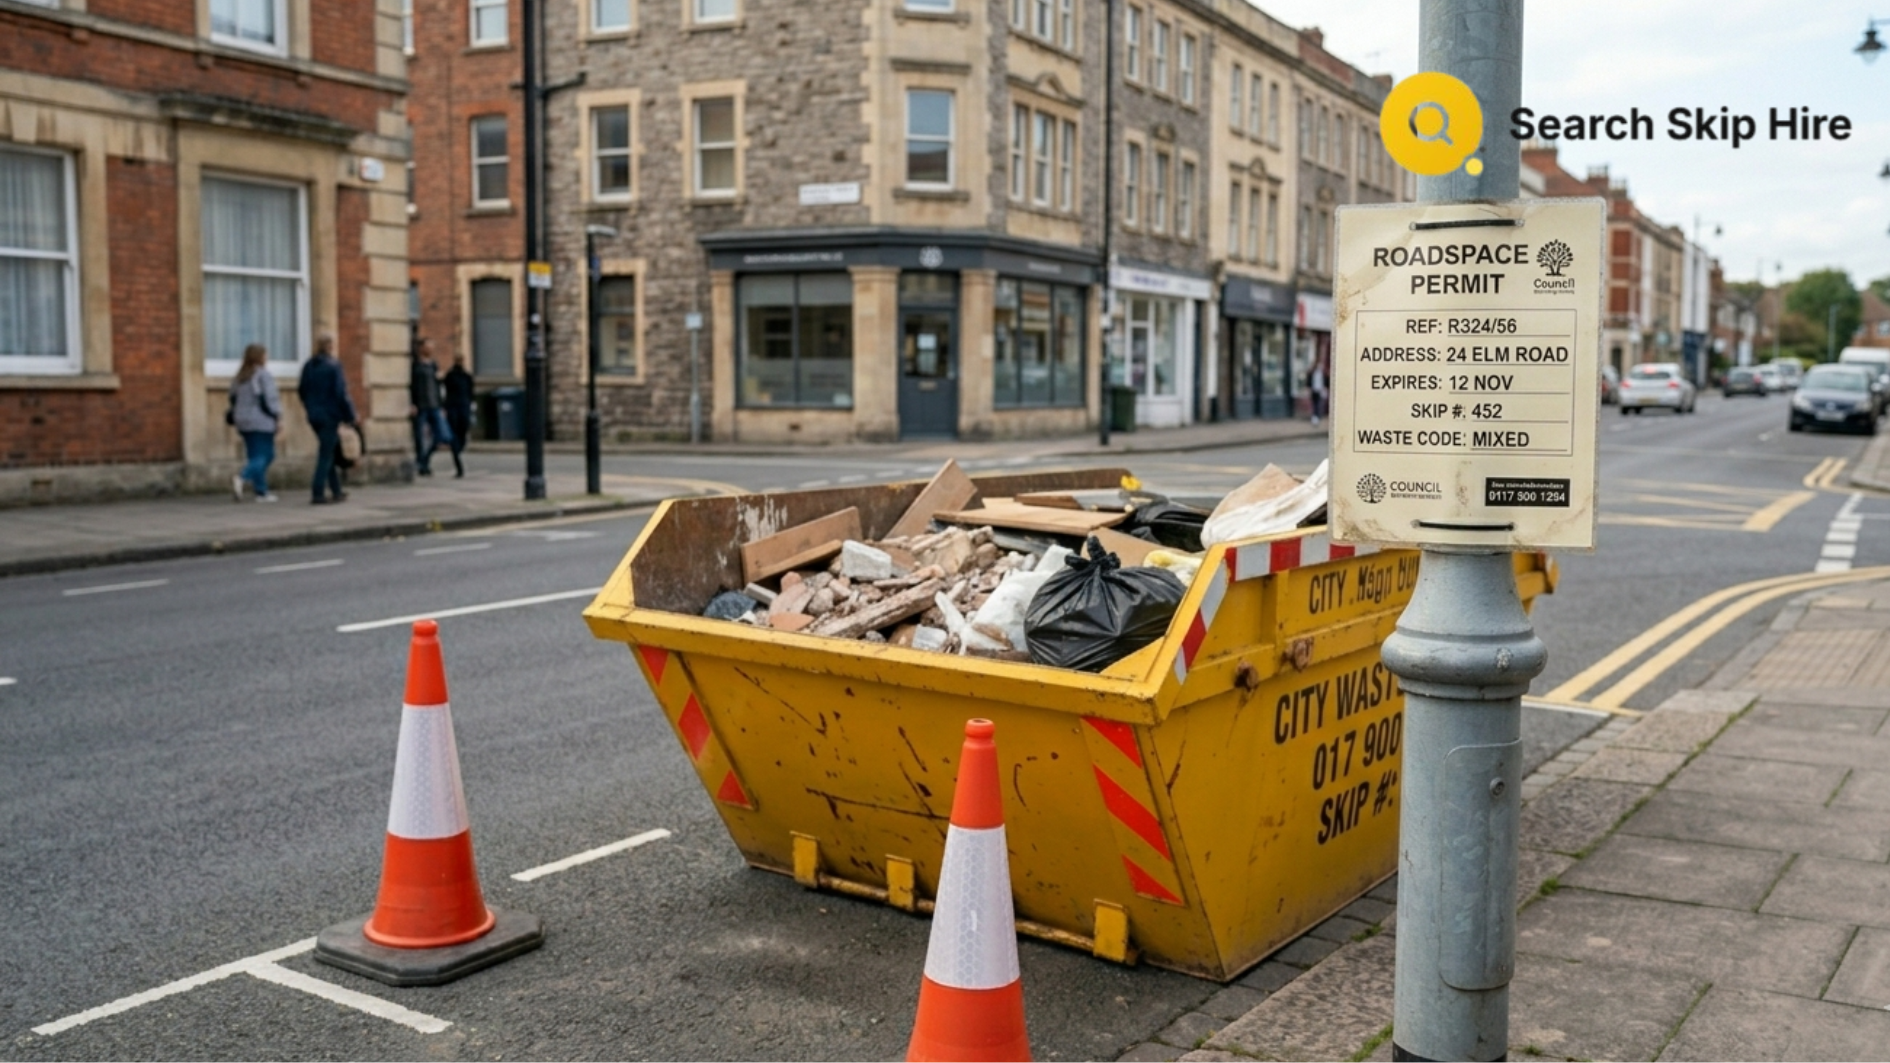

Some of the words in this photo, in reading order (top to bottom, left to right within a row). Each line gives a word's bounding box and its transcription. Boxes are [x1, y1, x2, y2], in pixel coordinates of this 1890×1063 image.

[1373, 243, 1529, 267] ROADSPACE
[1411, 273, 1506, 295] PERMIT
[1406, 318, 1442, 334] REF:
[1448, 318, 1517, 334] R324/56
[1360, 347, 1441, 362] ADDRESS:
[1446, 346, 1467, 362] 24
[1472, 346, 1510, 362] ELM
[1515, 346, 1569, 363] ROAD
[1371, 374, 1442, 390] EXPIRES:
[1449, 375, 1469, 391] 12
[1474, 374, 1514, 391] NOV
[1411, 402, 1449, 419] SKIP
[1471, 403, 1503, 419] 452
[1357, 430, 1413, 446] WASTE
[1417, 430, 1466, 447] CODE:
[1473, 431, 1530, 448] MIXED
[1389, 481, 1441, 493] COUNCIL
[1488, 490, 1515, 501] 0117
[1309, 568, 1348, 615] CITY
[1274, 679, 1330, 746] CITY
[1336, 661, 1404, 721] WAST
[1312, 729, 1357, 791] 017
[1362, 710, 1403, 768] 900
[1316, 780, 1370, 846] SKIP
[1373, 768, 1398, 817] #:
